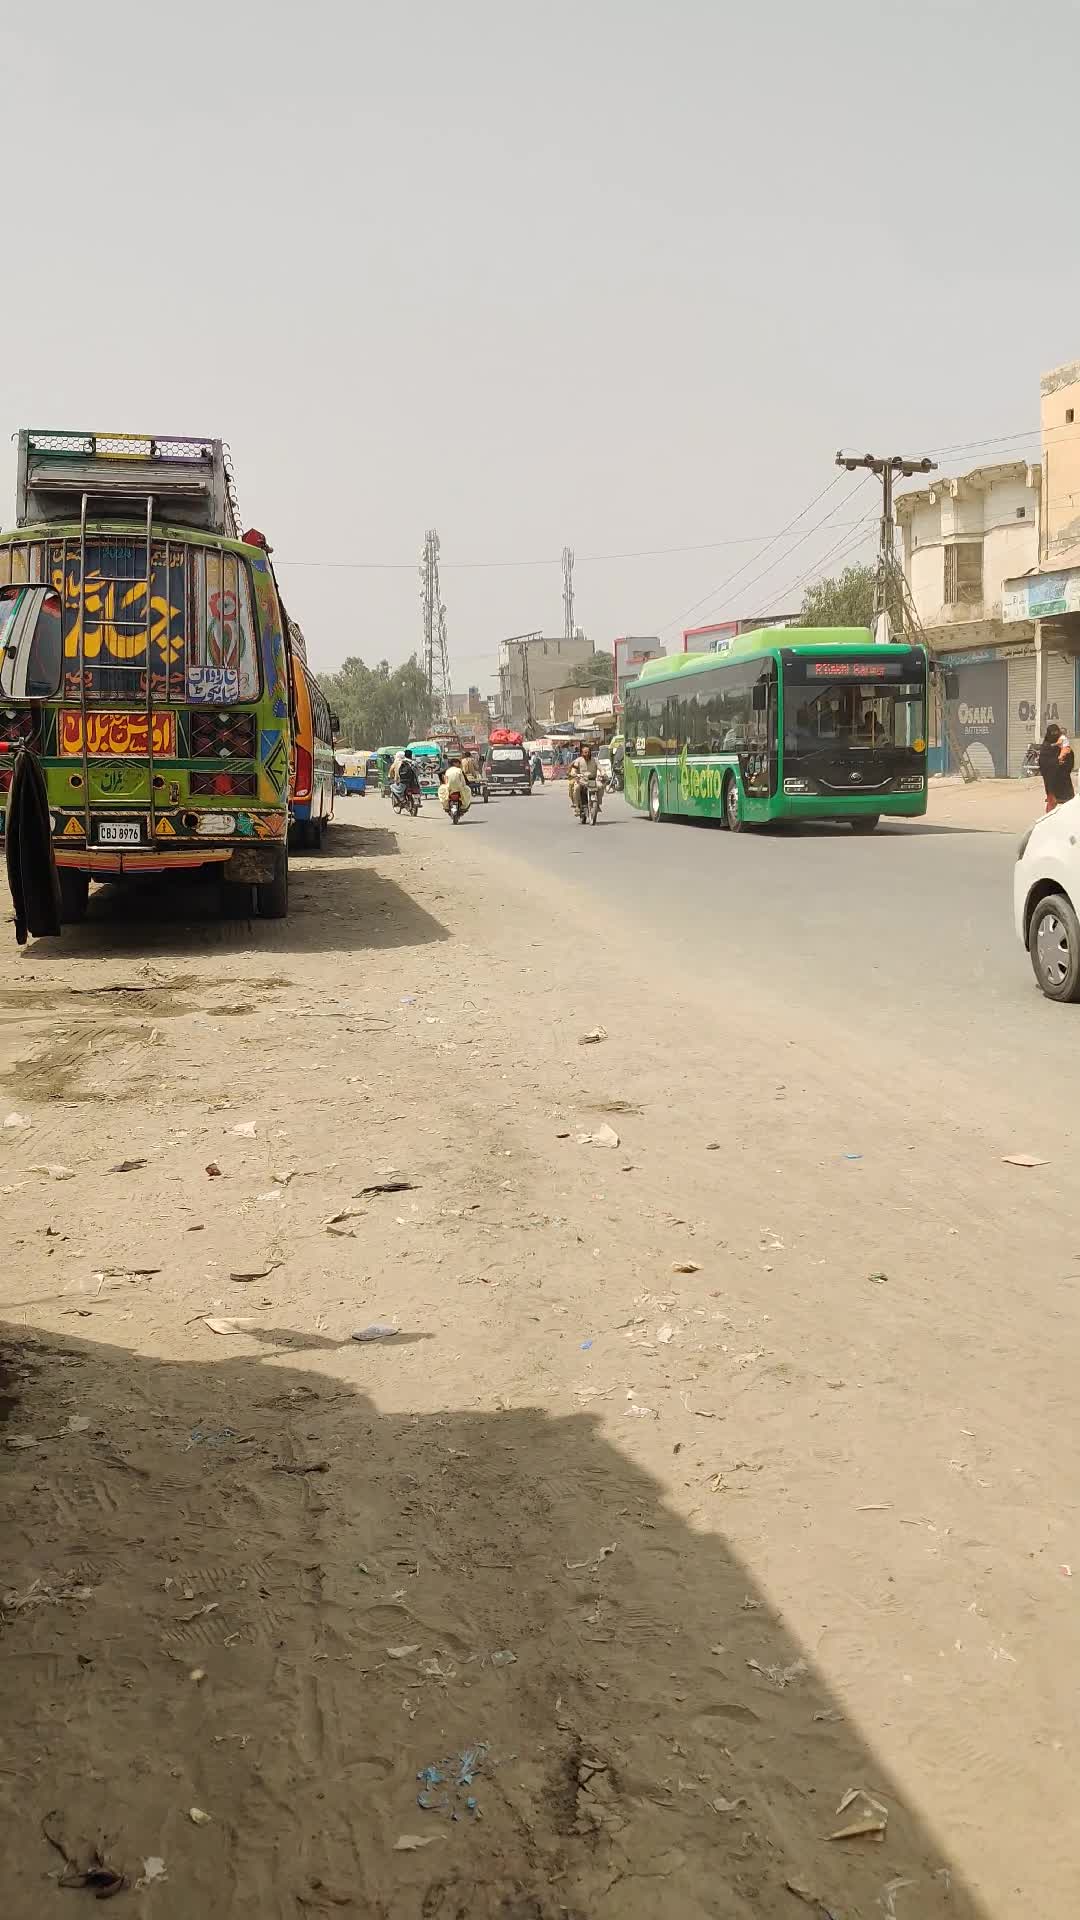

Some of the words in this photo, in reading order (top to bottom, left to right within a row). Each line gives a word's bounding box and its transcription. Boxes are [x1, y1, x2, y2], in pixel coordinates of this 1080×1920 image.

[959, 703, 994, 724] OSAKA
[1018, 700, 1059, 722] OSKA
[101, 827, 117, 839] CBJ
[119, 828, 139, 840] 8976
